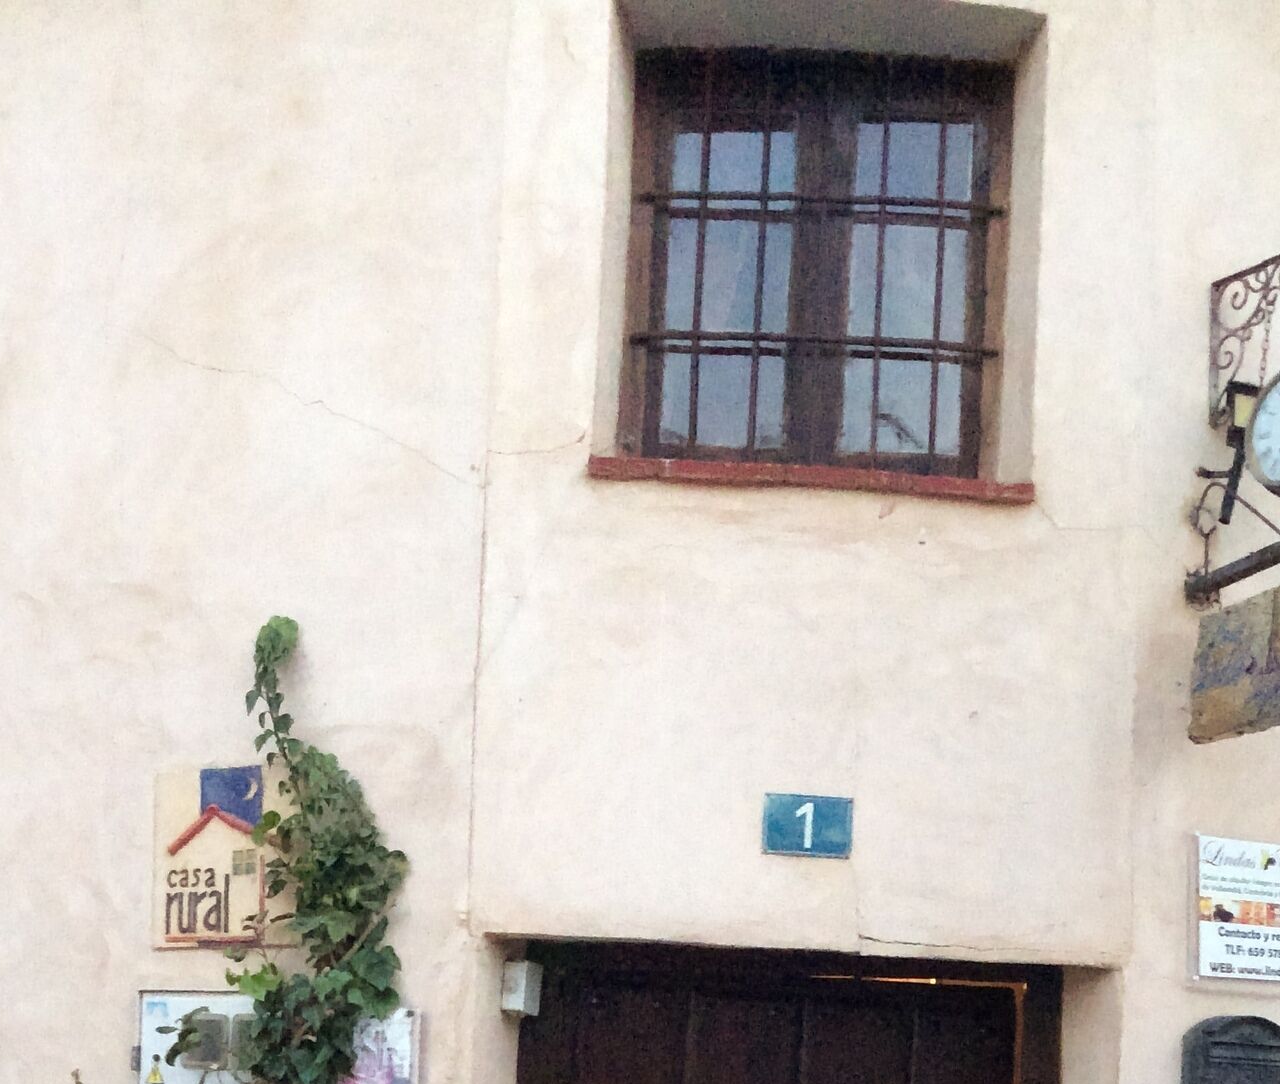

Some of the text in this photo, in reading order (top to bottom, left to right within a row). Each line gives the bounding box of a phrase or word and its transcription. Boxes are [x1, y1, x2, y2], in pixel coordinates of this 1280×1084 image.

[795, 802, 815, 849] 1
[166, 866, 217, 889] casa
[165, 873, 230, 935] rural
[1217, 926, 1261, 940] Contacto
[1248, 947, 1265, 957] 659
